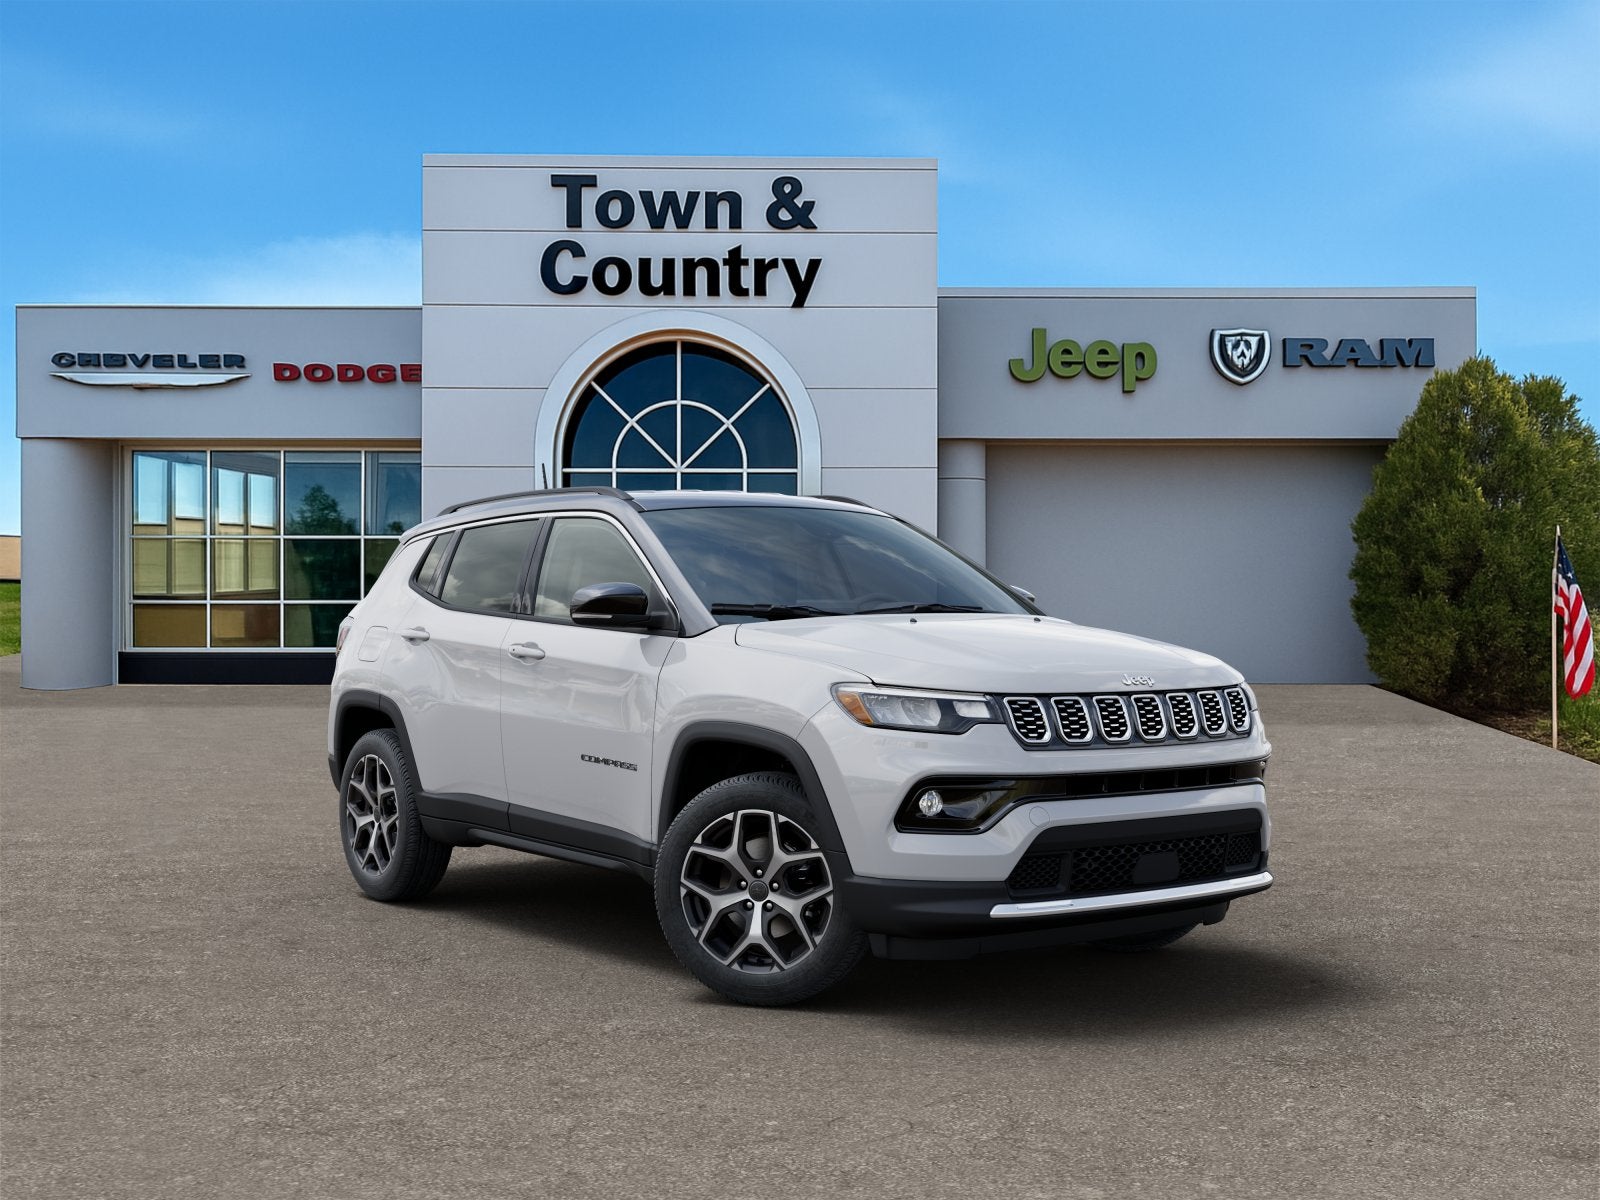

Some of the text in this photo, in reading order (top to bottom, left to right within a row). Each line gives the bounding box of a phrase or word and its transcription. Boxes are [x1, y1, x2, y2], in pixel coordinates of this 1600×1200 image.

[551, 174, 818, 230] Town &
[540, 239, 822, 308] Country
[1009, 328, 1157, 393] Jeep
[1283, 337, 1435, 367] RAM
[273, 363, 422, 383] DODGE
[1121, 673, 1155, 688] Jeep
[580, 753, 638, 771] COMPASS
